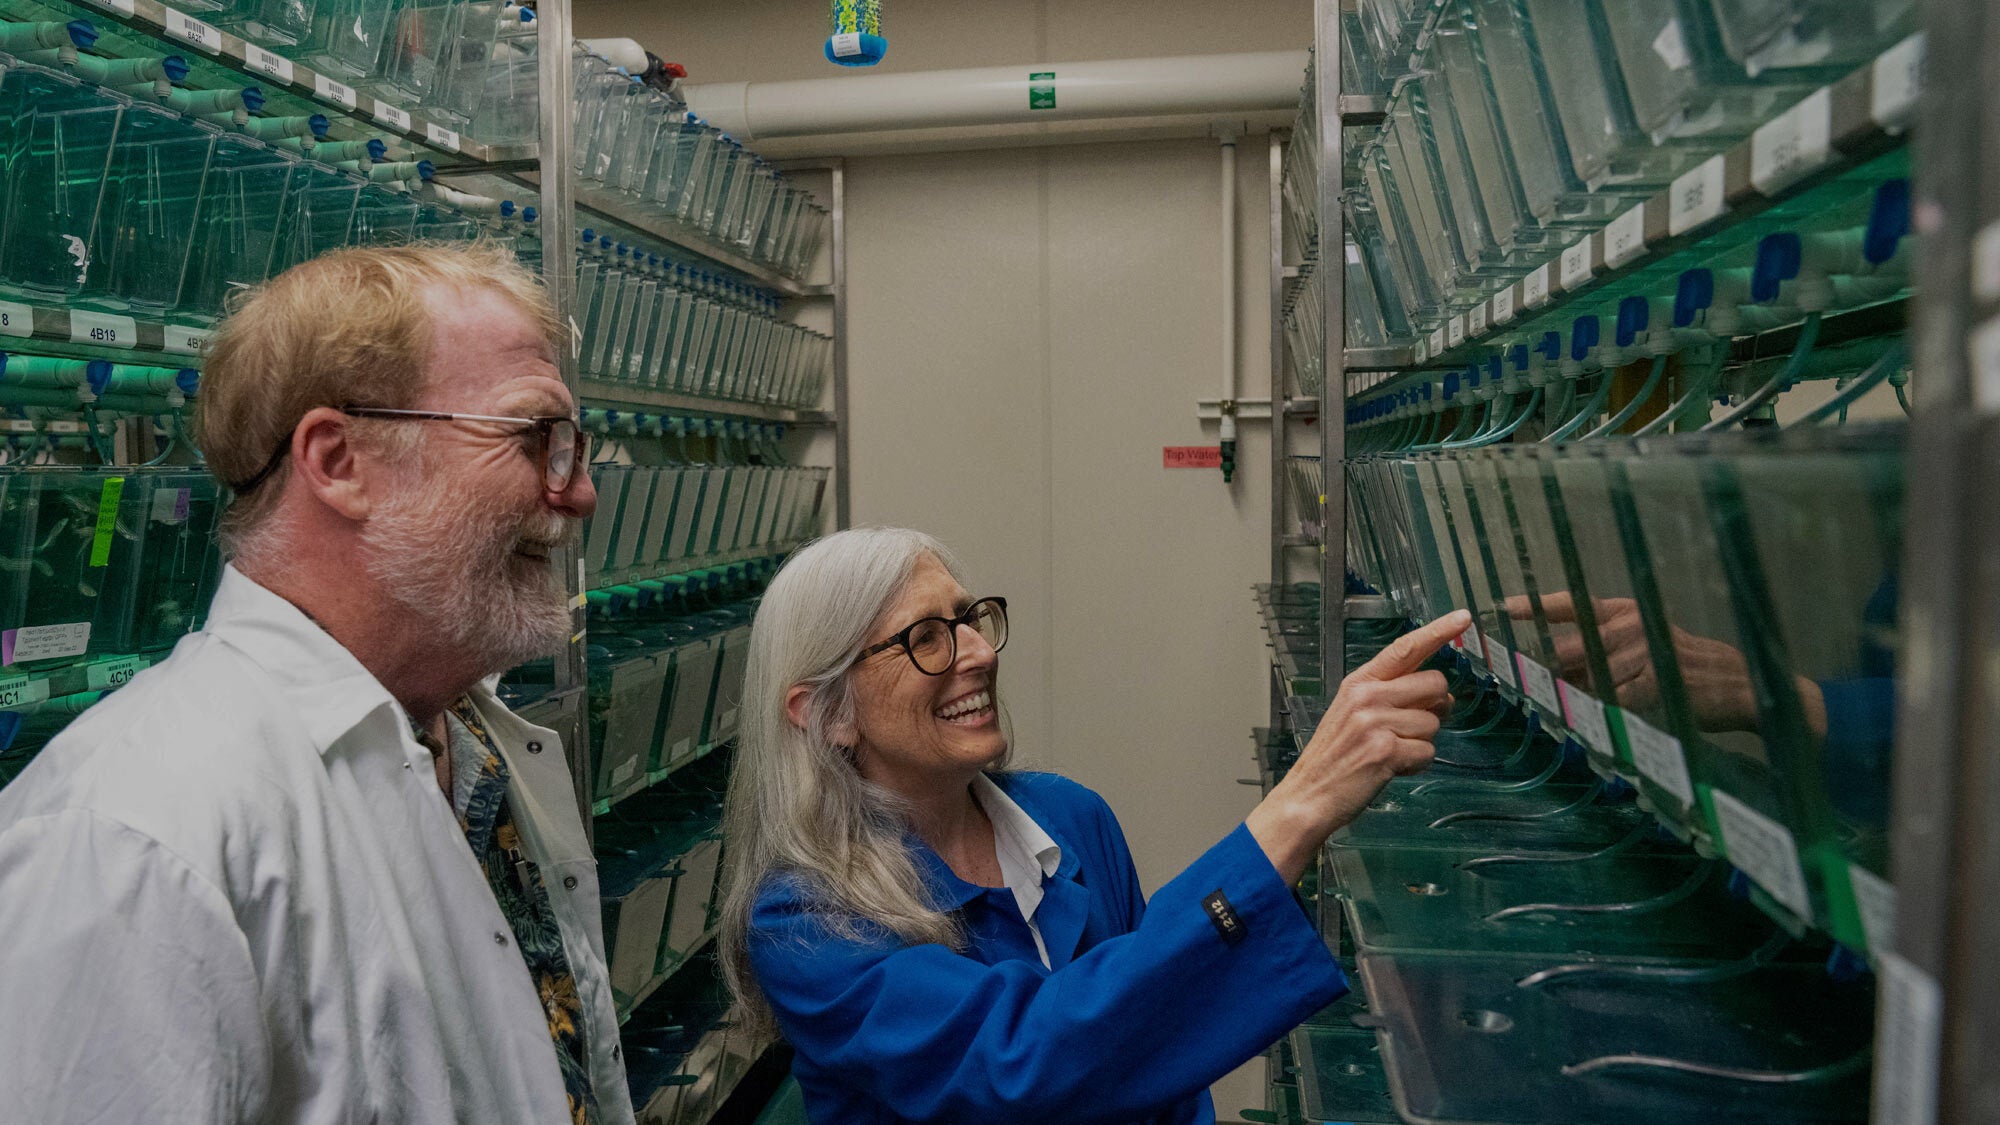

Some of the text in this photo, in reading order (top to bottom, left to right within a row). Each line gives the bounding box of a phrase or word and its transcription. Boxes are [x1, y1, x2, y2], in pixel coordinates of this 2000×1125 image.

[90, 328, 116, 342] 4B19
[1166, 449, 1220, 461] Tap Water
[110, 669, 134, 684] 4C19
[1211, 899, 1234, 928] 2112
